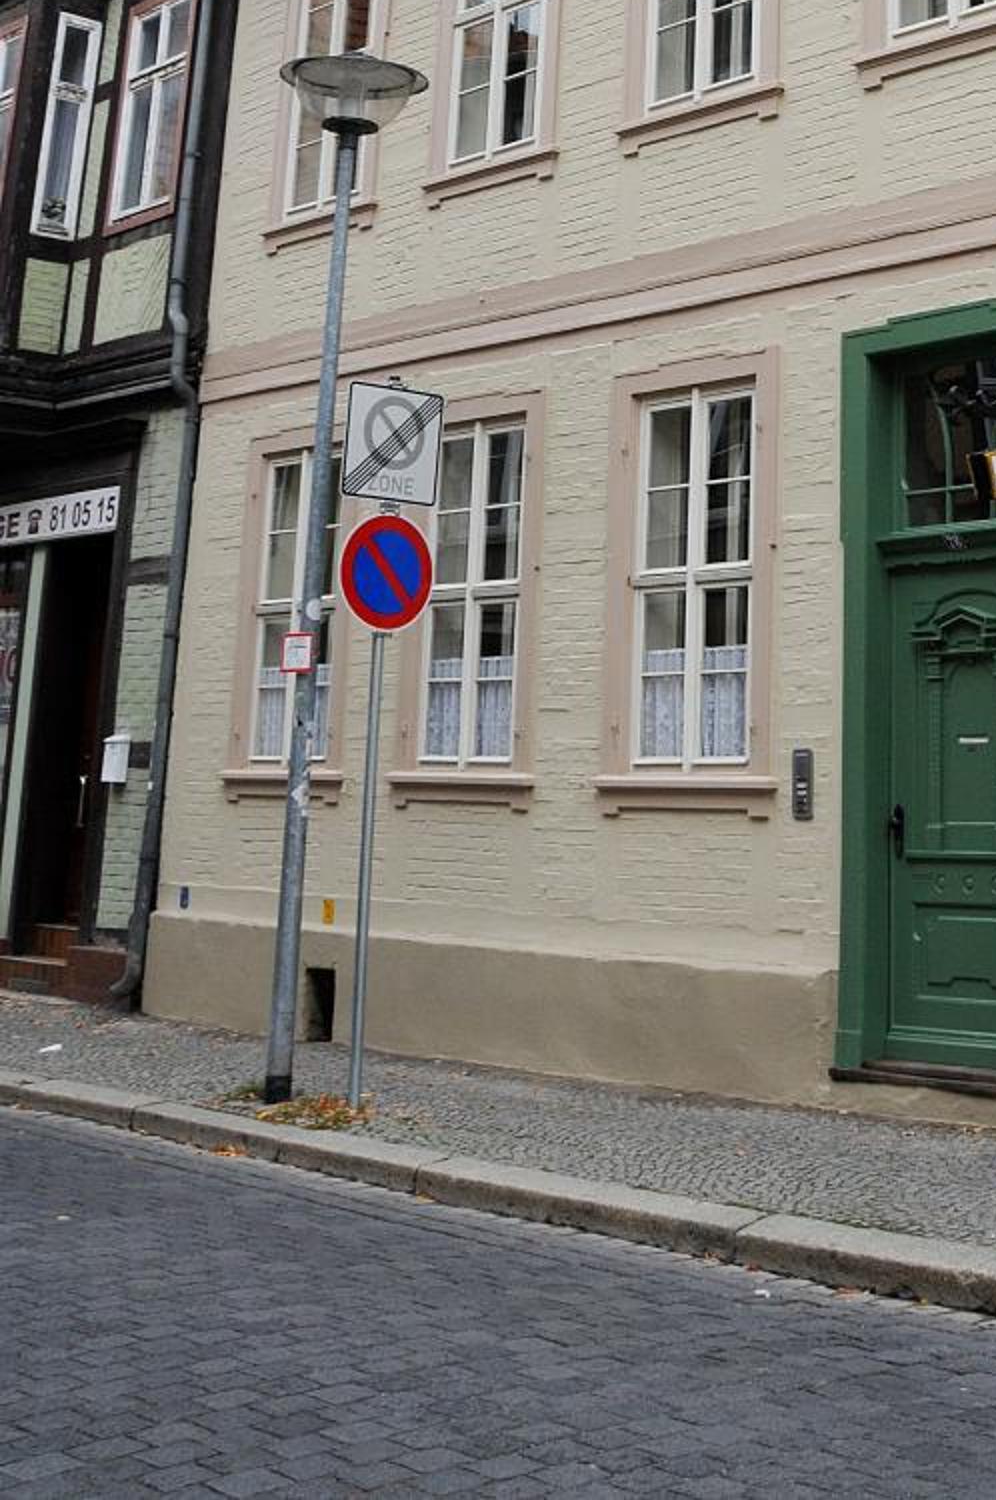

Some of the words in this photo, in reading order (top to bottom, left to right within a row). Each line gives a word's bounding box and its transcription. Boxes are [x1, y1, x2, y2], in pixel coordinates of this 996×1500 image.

[367, 474, 414, 496] ZONE
[49, 504, 67, 532] 81
[72, 499, 91, 529] 05
[97, 495, 116, 523] 15
